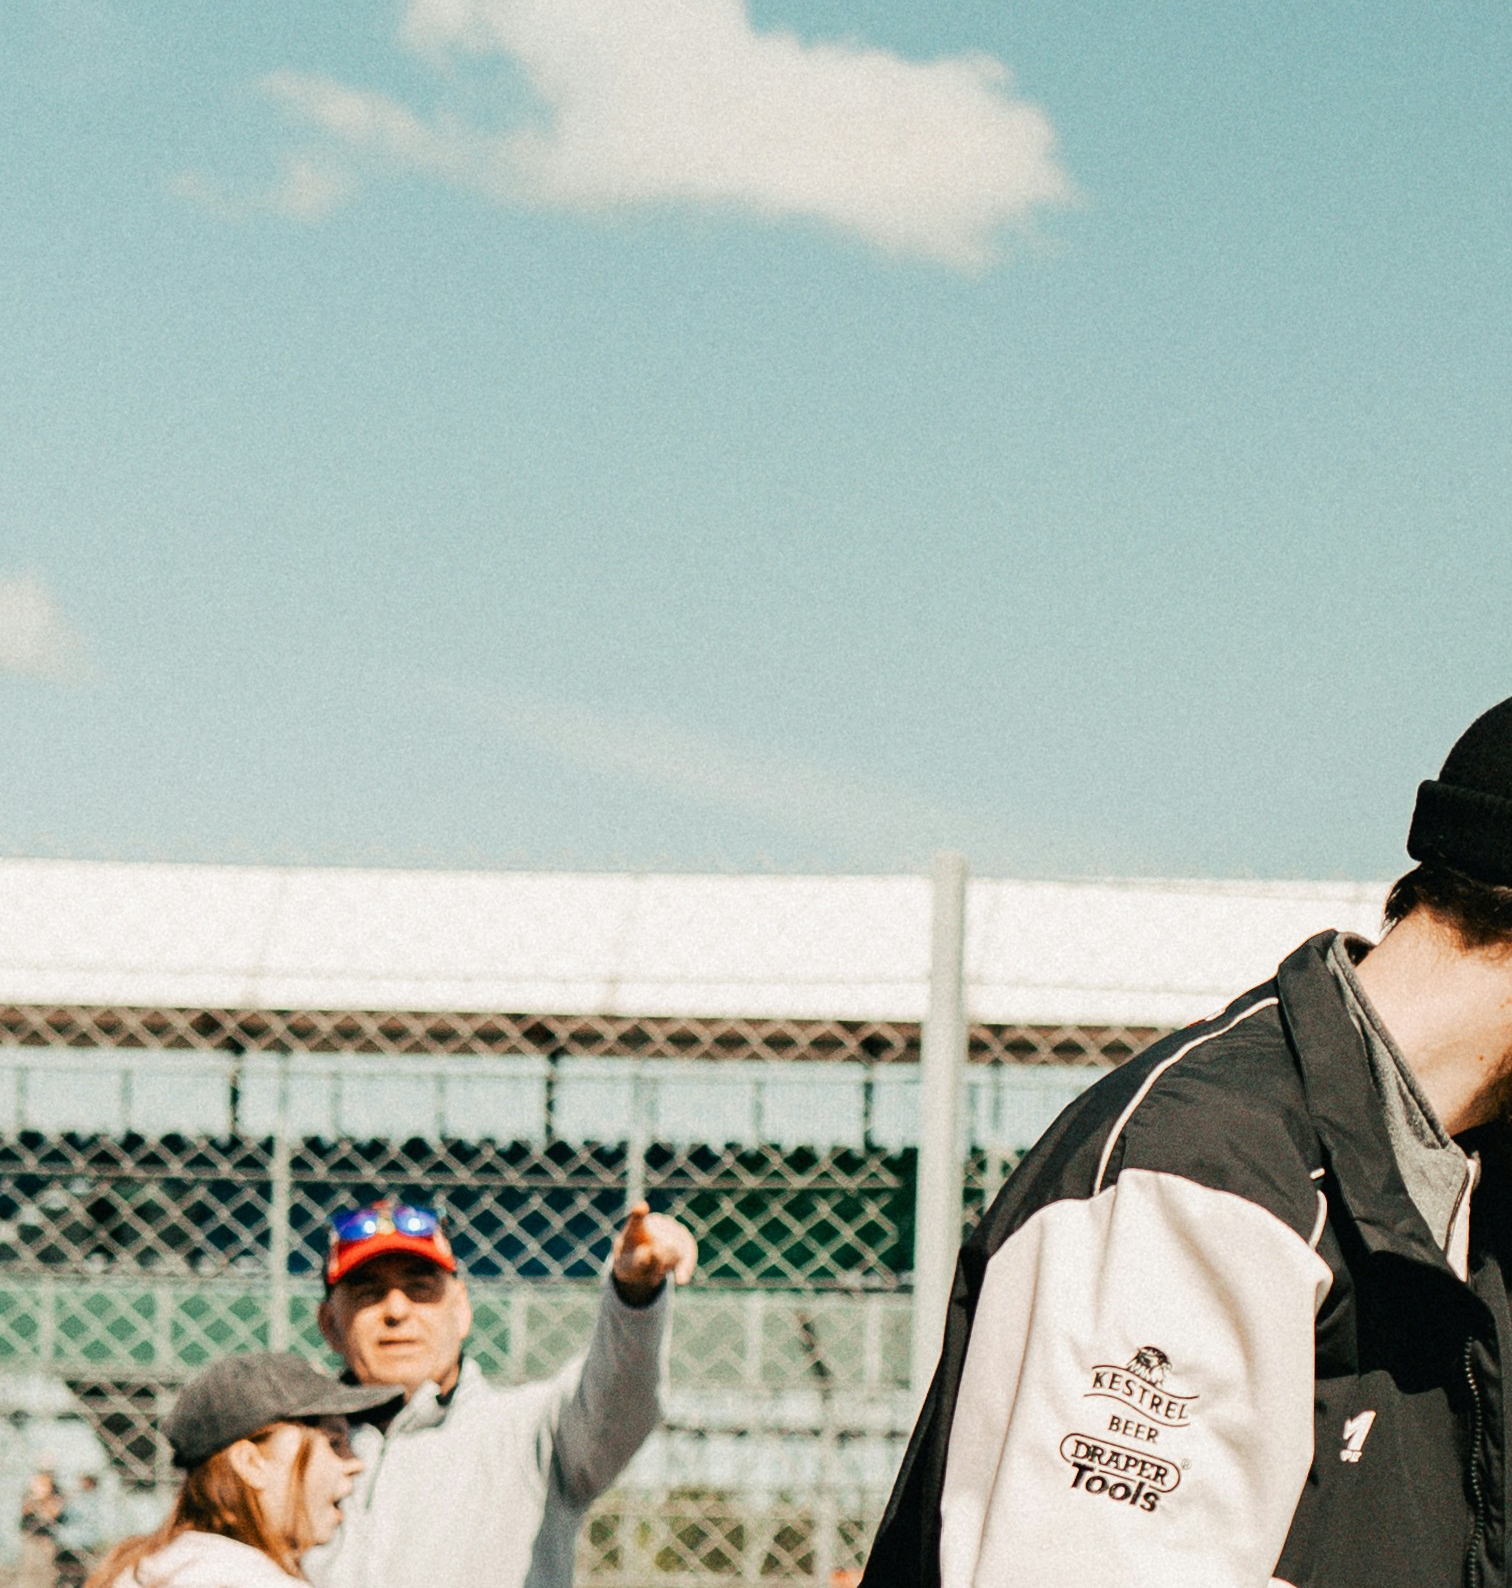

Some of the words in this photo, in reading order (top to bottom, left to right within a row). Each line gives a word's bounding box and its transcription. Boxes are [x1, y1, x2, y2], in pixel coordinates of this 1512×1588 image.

[1092, 1371, 1189, 1421] KESTREL
[1108, 1415, 1158, 1444] BEER
[1071, 1439, 1168, 1486] DRAPER
